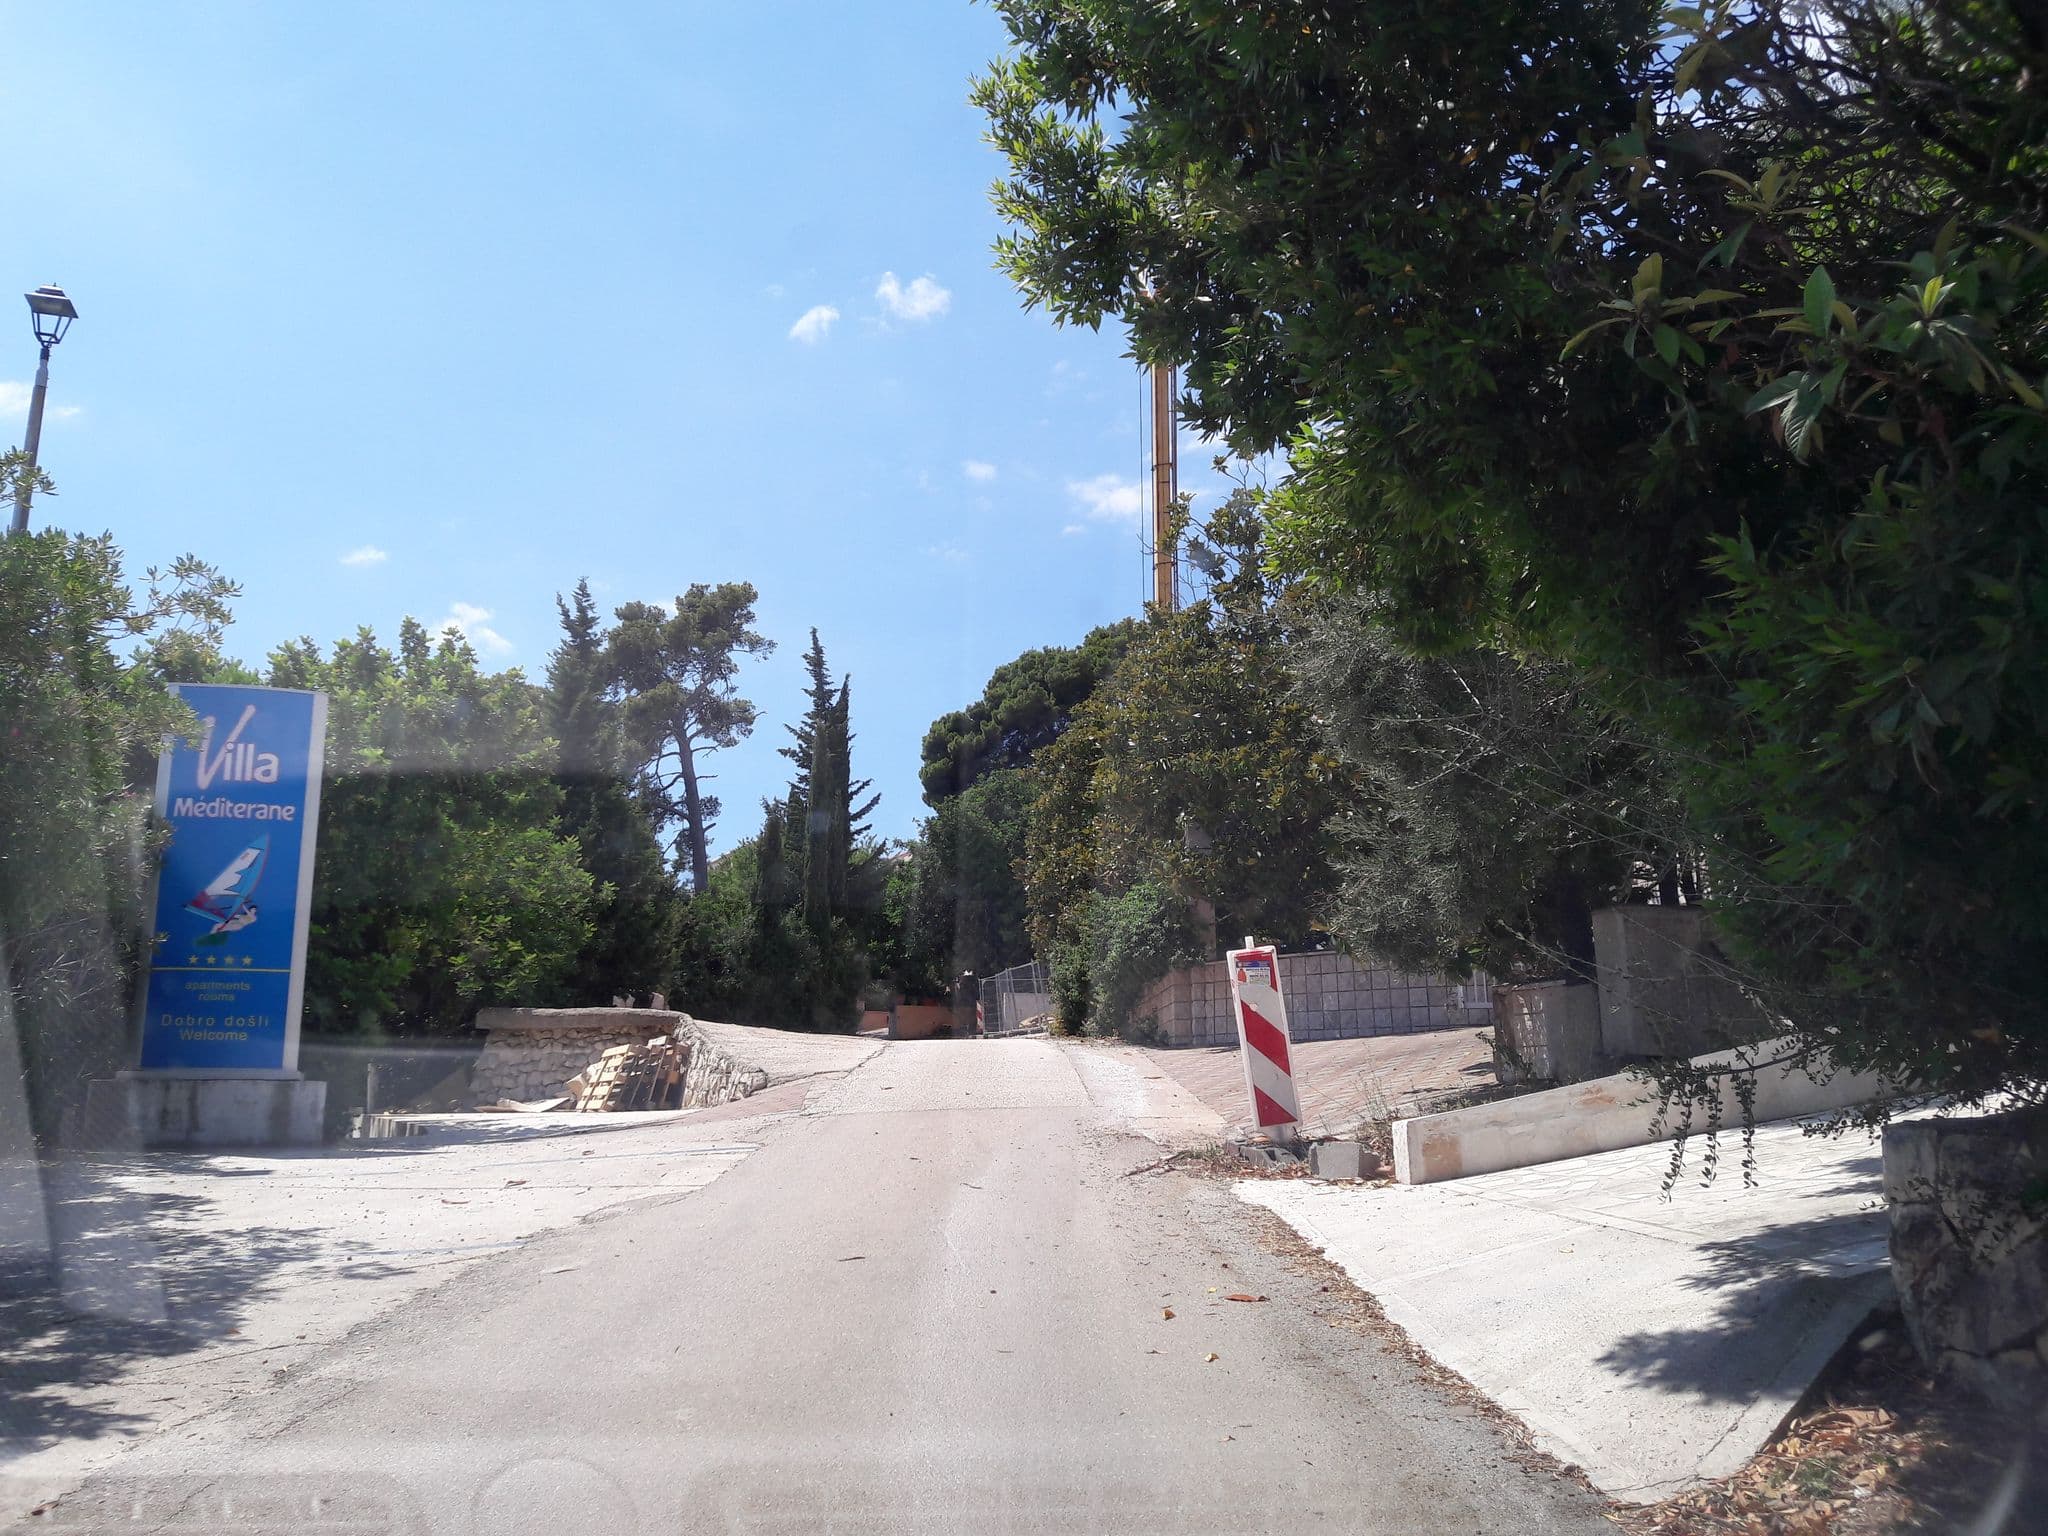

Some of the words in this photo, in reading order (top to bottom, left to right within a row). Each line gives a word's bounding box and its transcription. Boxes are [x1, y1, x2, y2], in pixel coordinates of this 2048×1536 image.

[197, 704, 280, 790] Villa
[161, 1014, 216, 1027] Dobro
[224, 1015, 269, 1027] došli
[180, 1028, 249, 1041] Welcome
